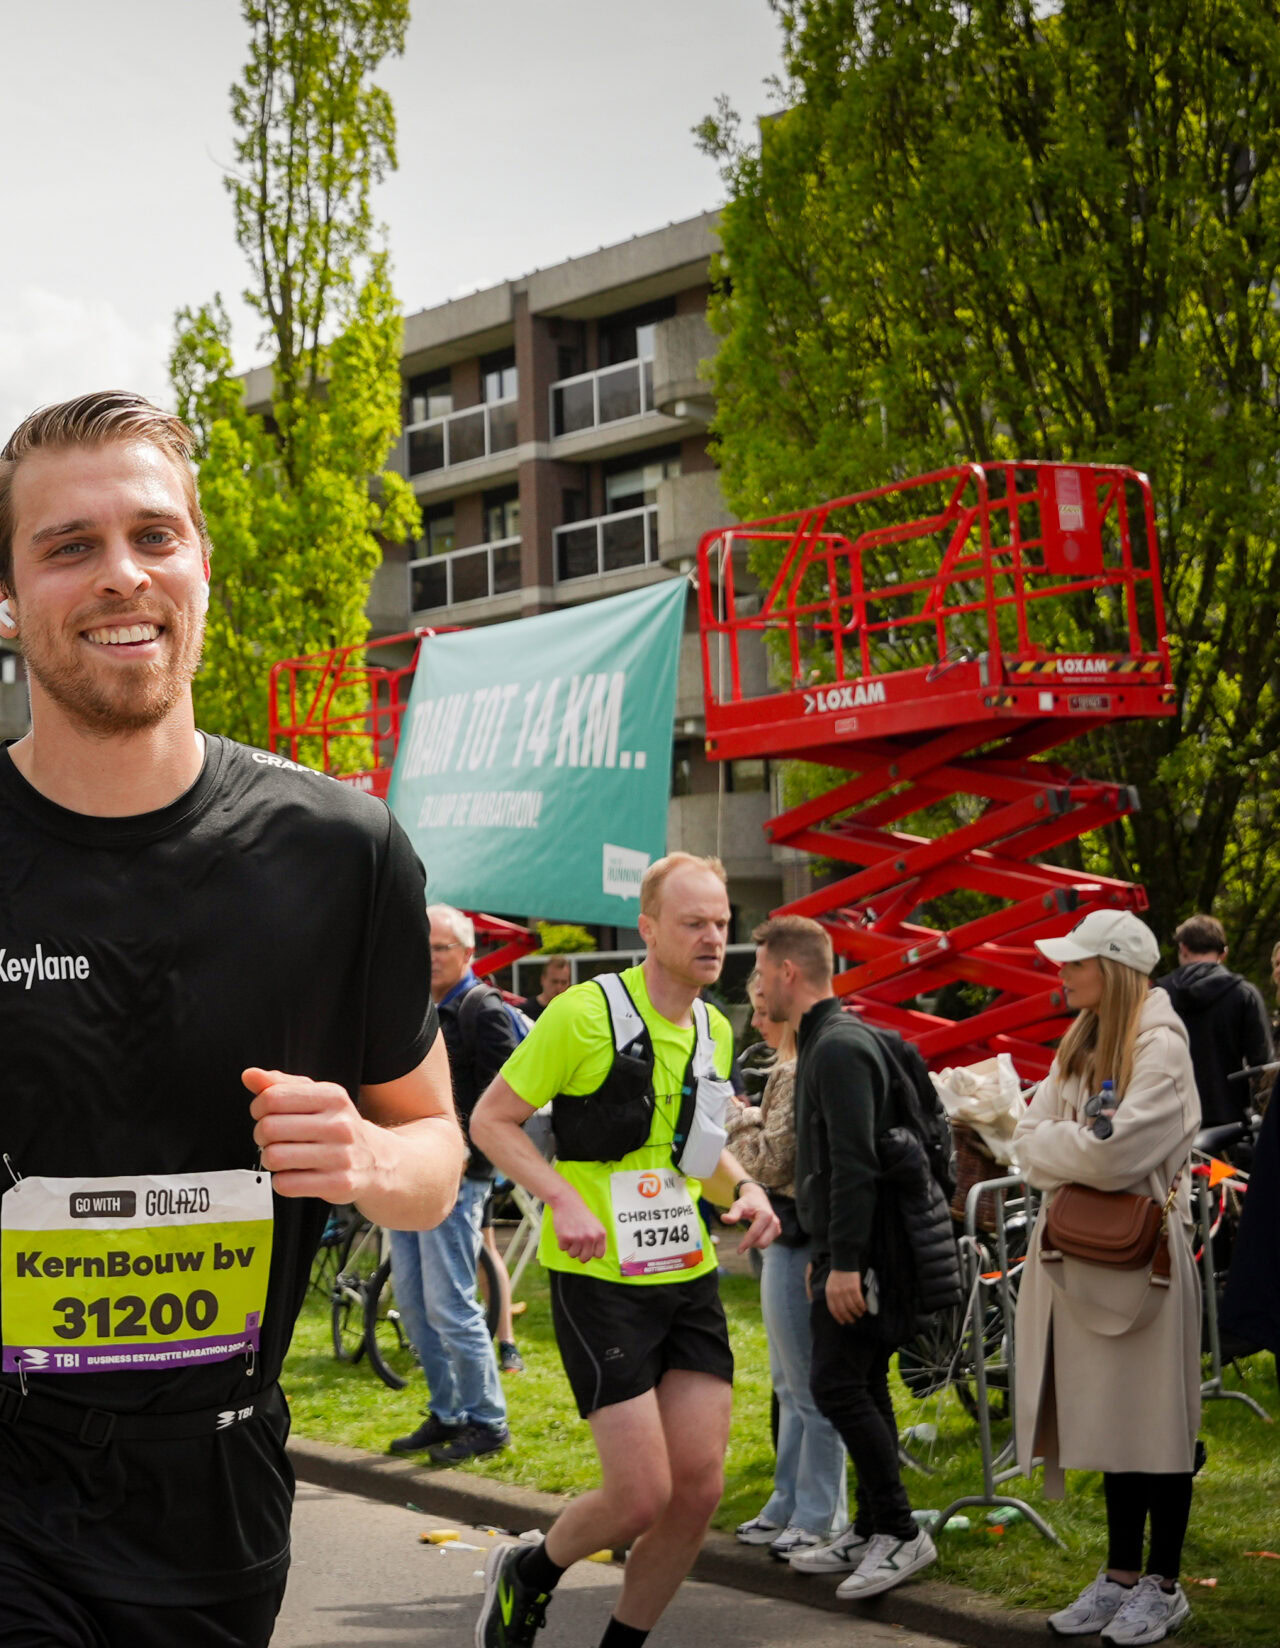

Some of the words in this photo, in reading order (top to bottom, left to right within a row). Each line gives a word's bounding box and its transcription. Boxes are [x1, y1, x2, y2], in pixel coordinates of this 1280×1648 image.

[1057, 658, 1108, 674] LOXAM
[816, 681, 887, 713] LOXAM
[402, 692, 470, 781] TRAIN
[455, 682, 520, 772] TOT
[512, 676, 563, 768] 14
[554, 671, 647, 770] KM..
[75, 1197, 90, 1213] GO
[93, 1196, 121, 1212] WITH
[145, 1187, 210, 1217] GOLAZO
[617, 1204, 694, 1223] CHRISTOPHE
[632, 1223, 690, 1248] 13748
[16, 1250, 206, 1279] KernBouw
[213, 1242, 256, 1271] bv
[52, 1289, 219, 1340] 31200
[53, 1353, 80, 1368] TBI
[86, 1355, 132, 1366] BUSINESS
[132, 1351, 182, 1363] ESTAFETTE
[182, 1345, 228, 1359] MARATHON
[237, 1405, 254, 1420] TBI
